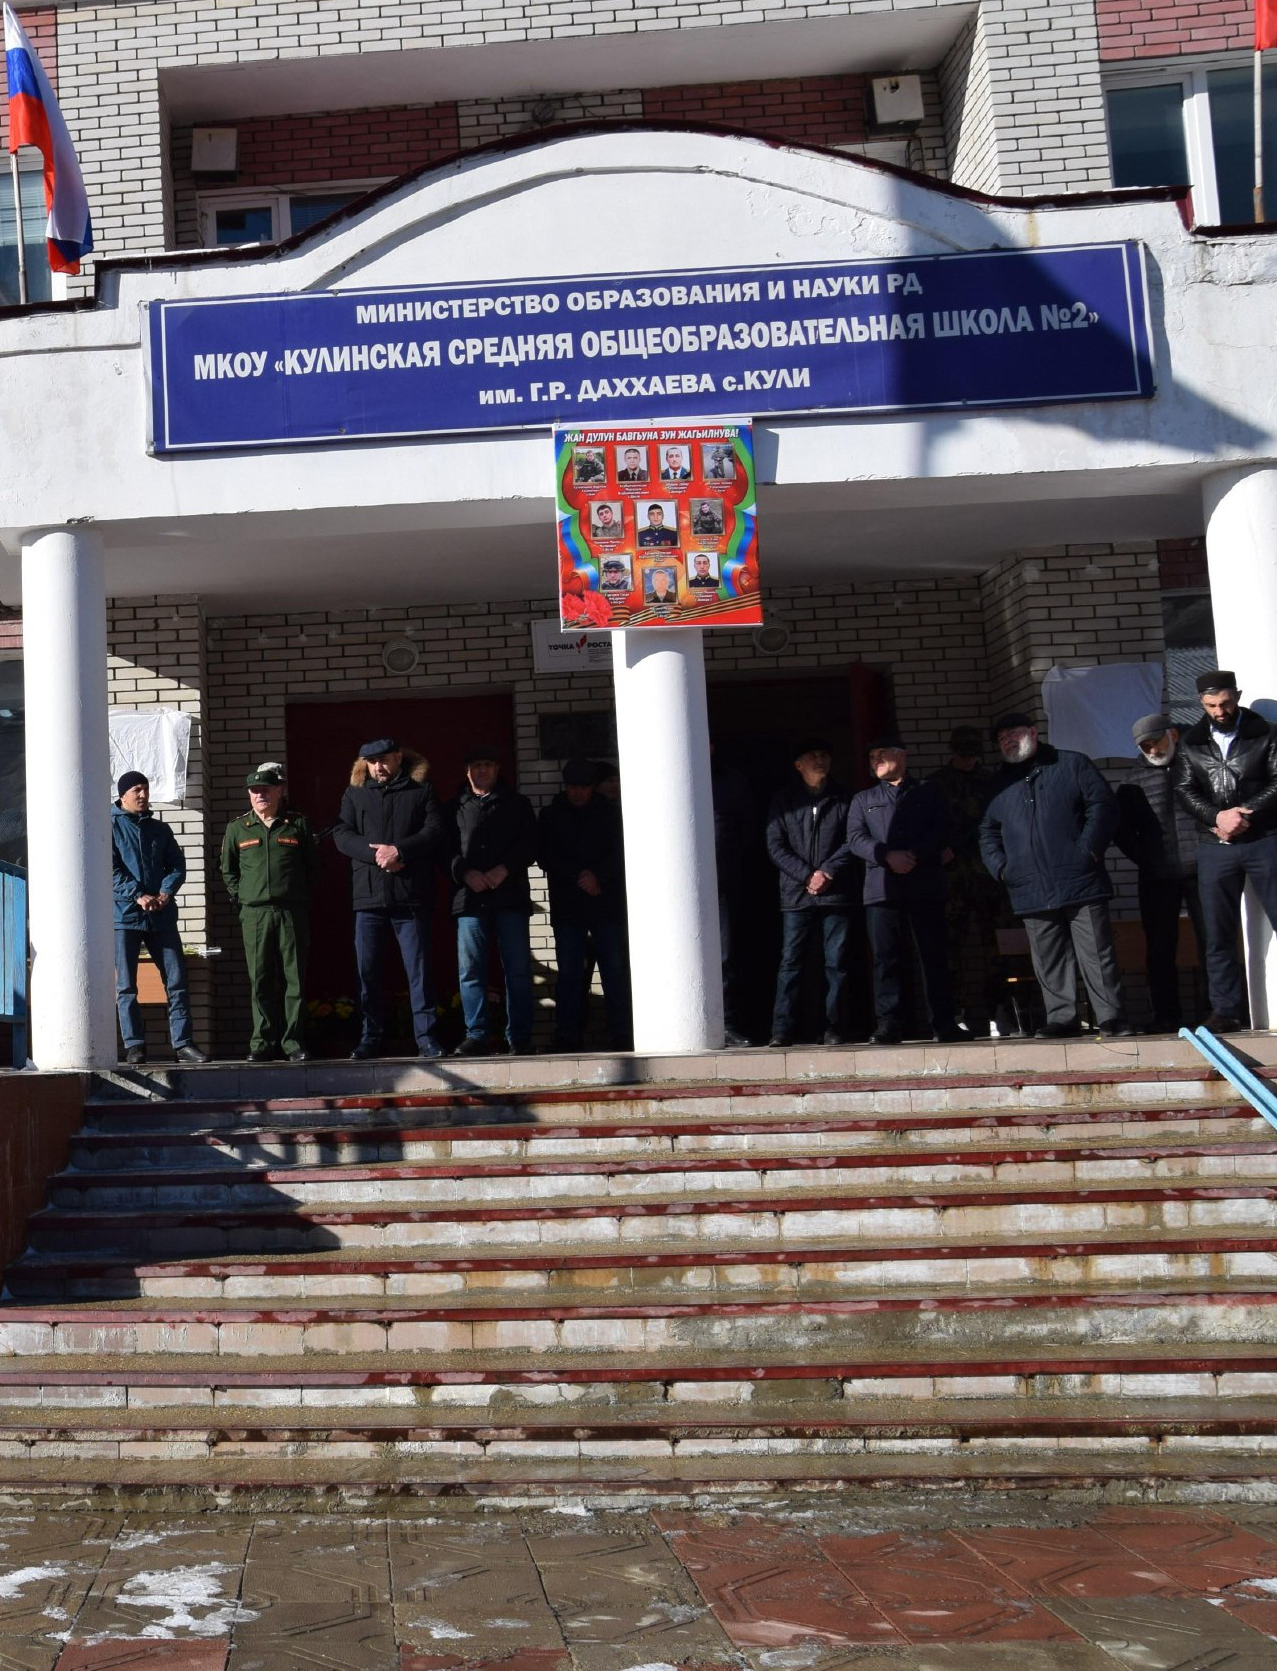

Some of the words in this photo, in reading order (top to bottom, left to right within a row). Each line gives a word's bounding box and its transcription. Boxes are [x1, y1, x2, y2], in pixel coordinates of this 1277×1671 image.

[356, 293, 560, 324] МИНИСТЕРСТВО
[566, 282, 760, 311] ОБРАЗОВАНИЯ
[767, 280, 785, 300] И
[792, 275, 880, 299] НАУКИ
[886, 272, 923, 296] РД
[193, 351, 268, 380] МКОУ
[274, 340, 441, 376] «КУЛИНСКАЯ
[448, 332, 574, 367] СРЕДНЯЯ
[580, 312, 925, 359] ОБЩЕОБРАЗОВАТЕЛЬНАЯ
[932, 305, 1034, 338] ШКОЛА
[1040, 301, 1100, 331] №2»
[479, 388, 524, 405] им.
[530, 381, 572, 402] Г.Р.
[577, 373, 716, 402] ДАХХАЕВА
[722, 368, 811, 392] с.КУЛИ
[564, 431, 585, 443] ЖАН
[586, 430, 615, 444] ДУЛУН
[660, 429, 677, 440] ЗУН
[548, 643, 575, 651] ТОЧКА
